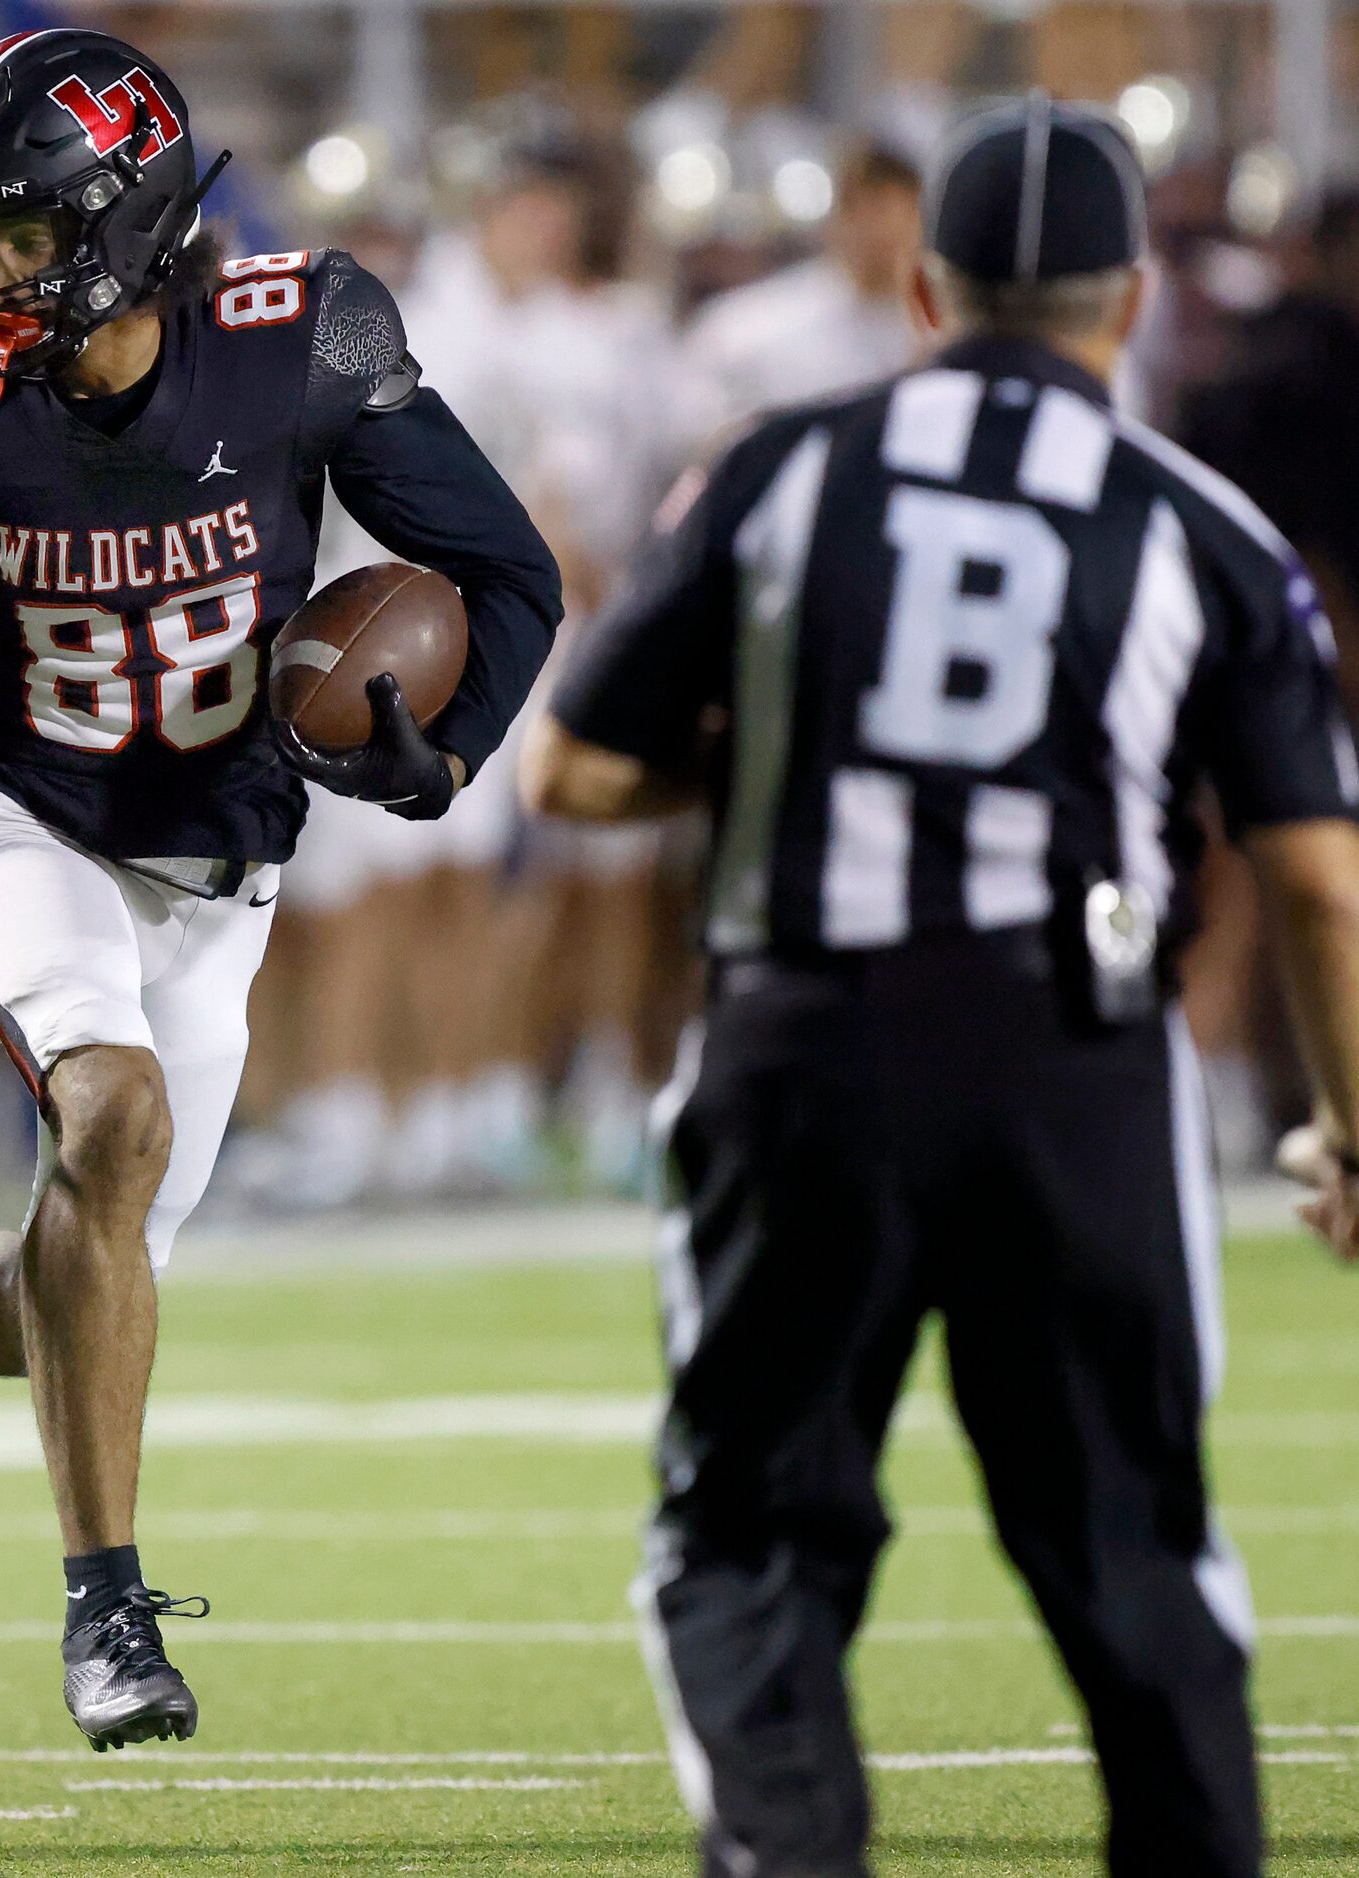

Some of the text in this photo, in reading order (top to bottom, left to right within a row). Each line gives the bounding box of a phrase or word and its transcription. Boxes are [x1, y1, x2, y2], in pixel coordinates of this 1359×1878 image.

[215, 249, 309, 332] 88
[15, 570, 262, 755] 88
[857, 484, 1073, 771] B
